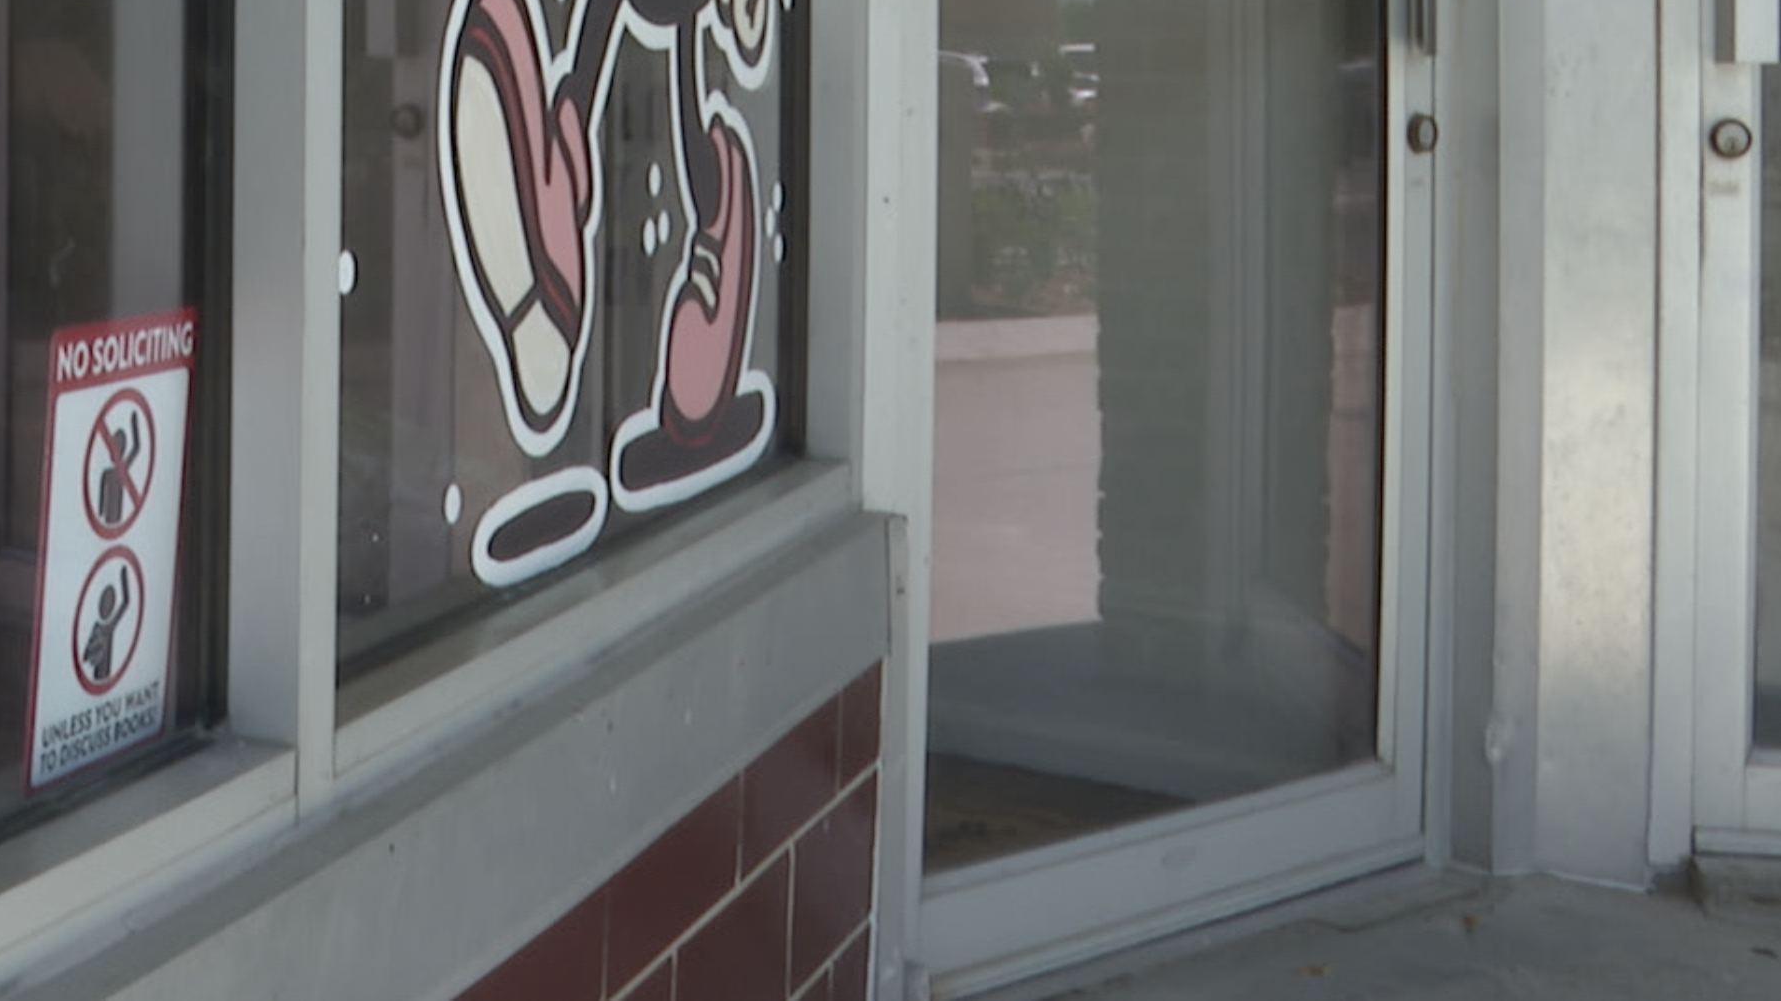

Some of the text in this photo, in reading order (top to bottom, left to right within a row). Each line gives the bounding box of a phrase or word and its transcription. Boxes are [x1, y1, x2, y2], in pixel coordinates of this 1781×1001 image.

[57, 321, 194, 383] NO SOLICITING
[42, 707, 93, 748] UNLESS
[124, 679, 160, 708] WANT
[39, 749, 57, 775] TO
[59, 725, 112, 767] DISCUSS
